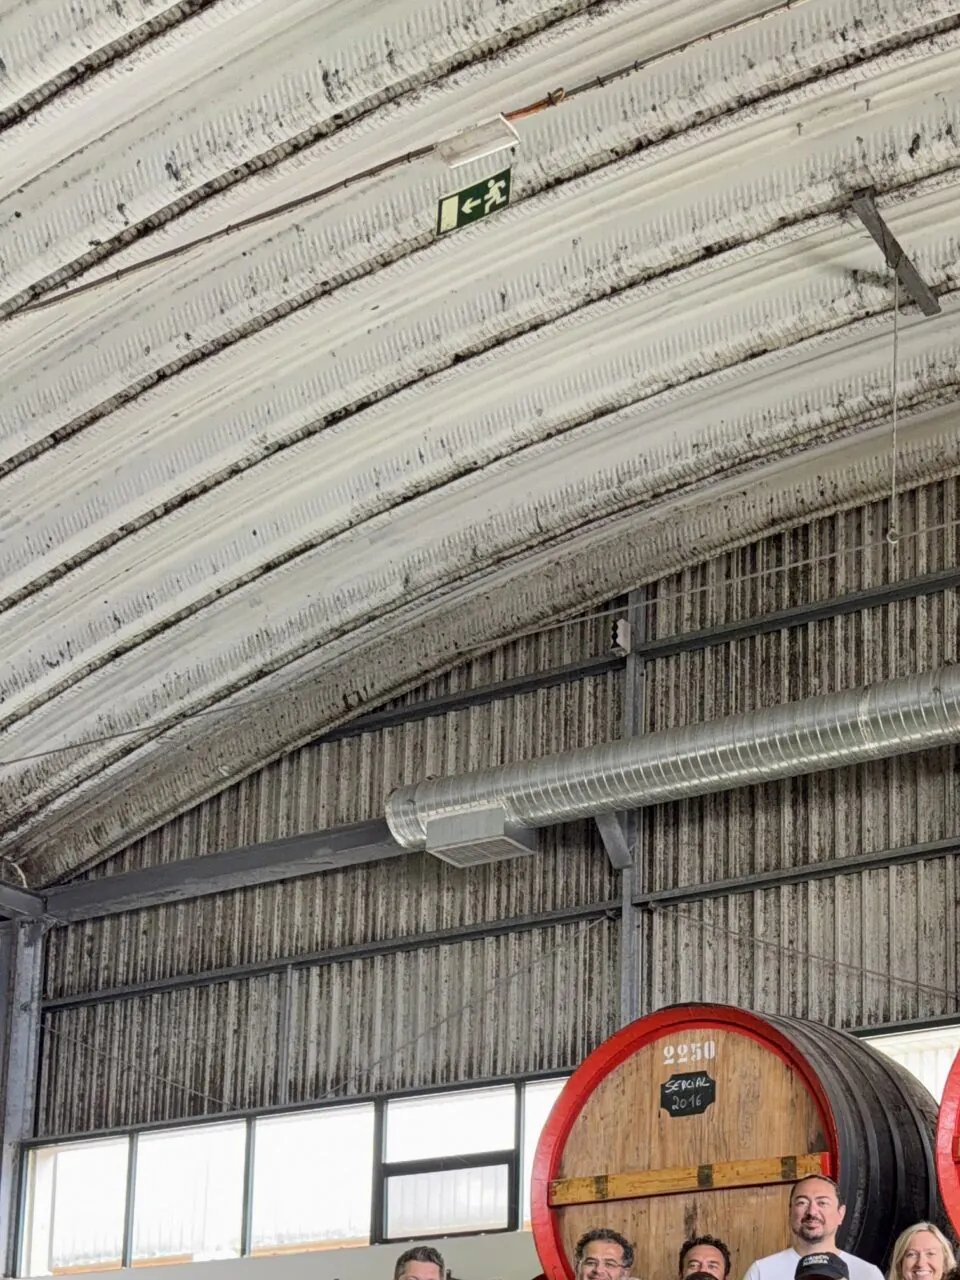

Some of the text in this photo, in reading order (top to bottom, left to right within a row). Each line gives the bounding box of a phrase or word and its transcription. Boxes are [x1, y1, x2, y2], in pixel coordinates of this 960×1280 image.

[663, 1040, 716, 1065] 2250
[665, 1076, 710, 1094] SERCIAL
[671, 1094, 702, 1111] 2016
